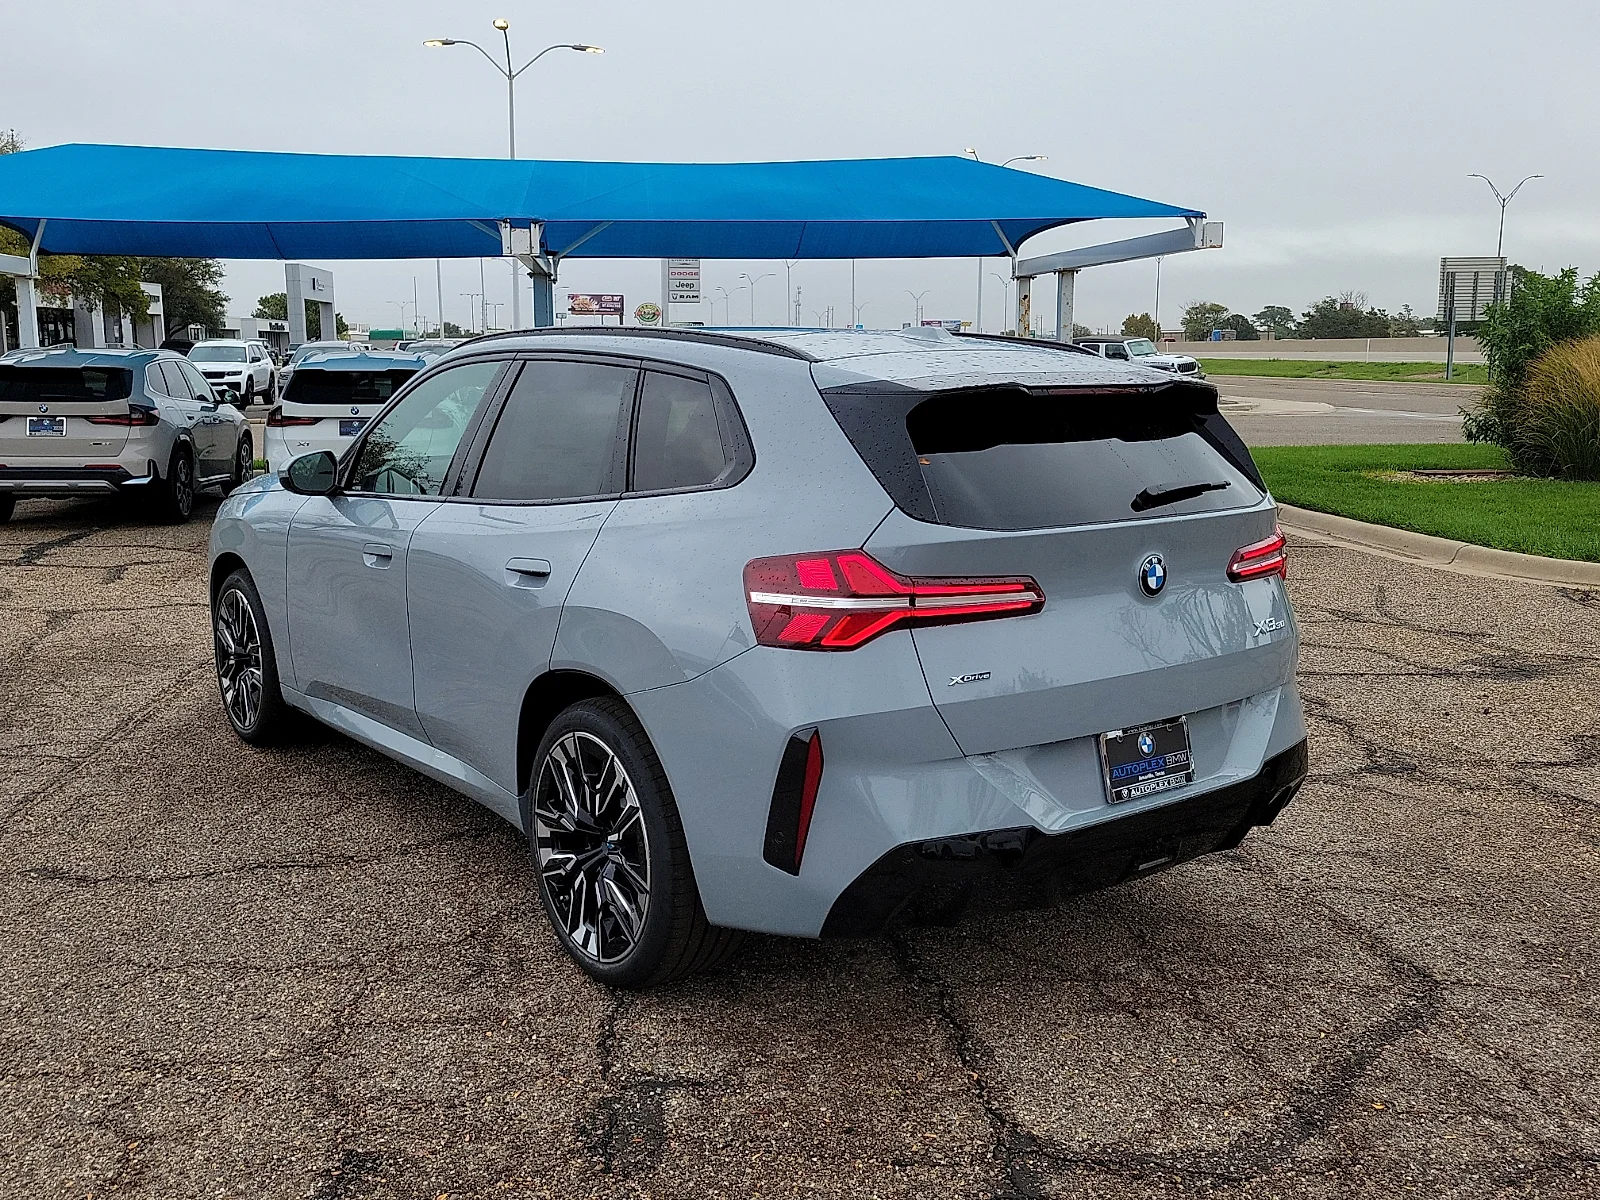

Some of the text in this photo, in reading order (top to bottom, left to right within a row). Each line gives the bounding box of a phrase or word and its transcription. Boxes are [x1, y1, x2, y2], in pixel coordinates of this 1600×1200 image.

[675, 281, 695, 290] Jeep
[1143, 557, 1166, 571] BMW
[1112, 753, 1187, 778] AUTOPLEX BMW
[1130, 774, 1186, 797] AUTOPLEX BMW
